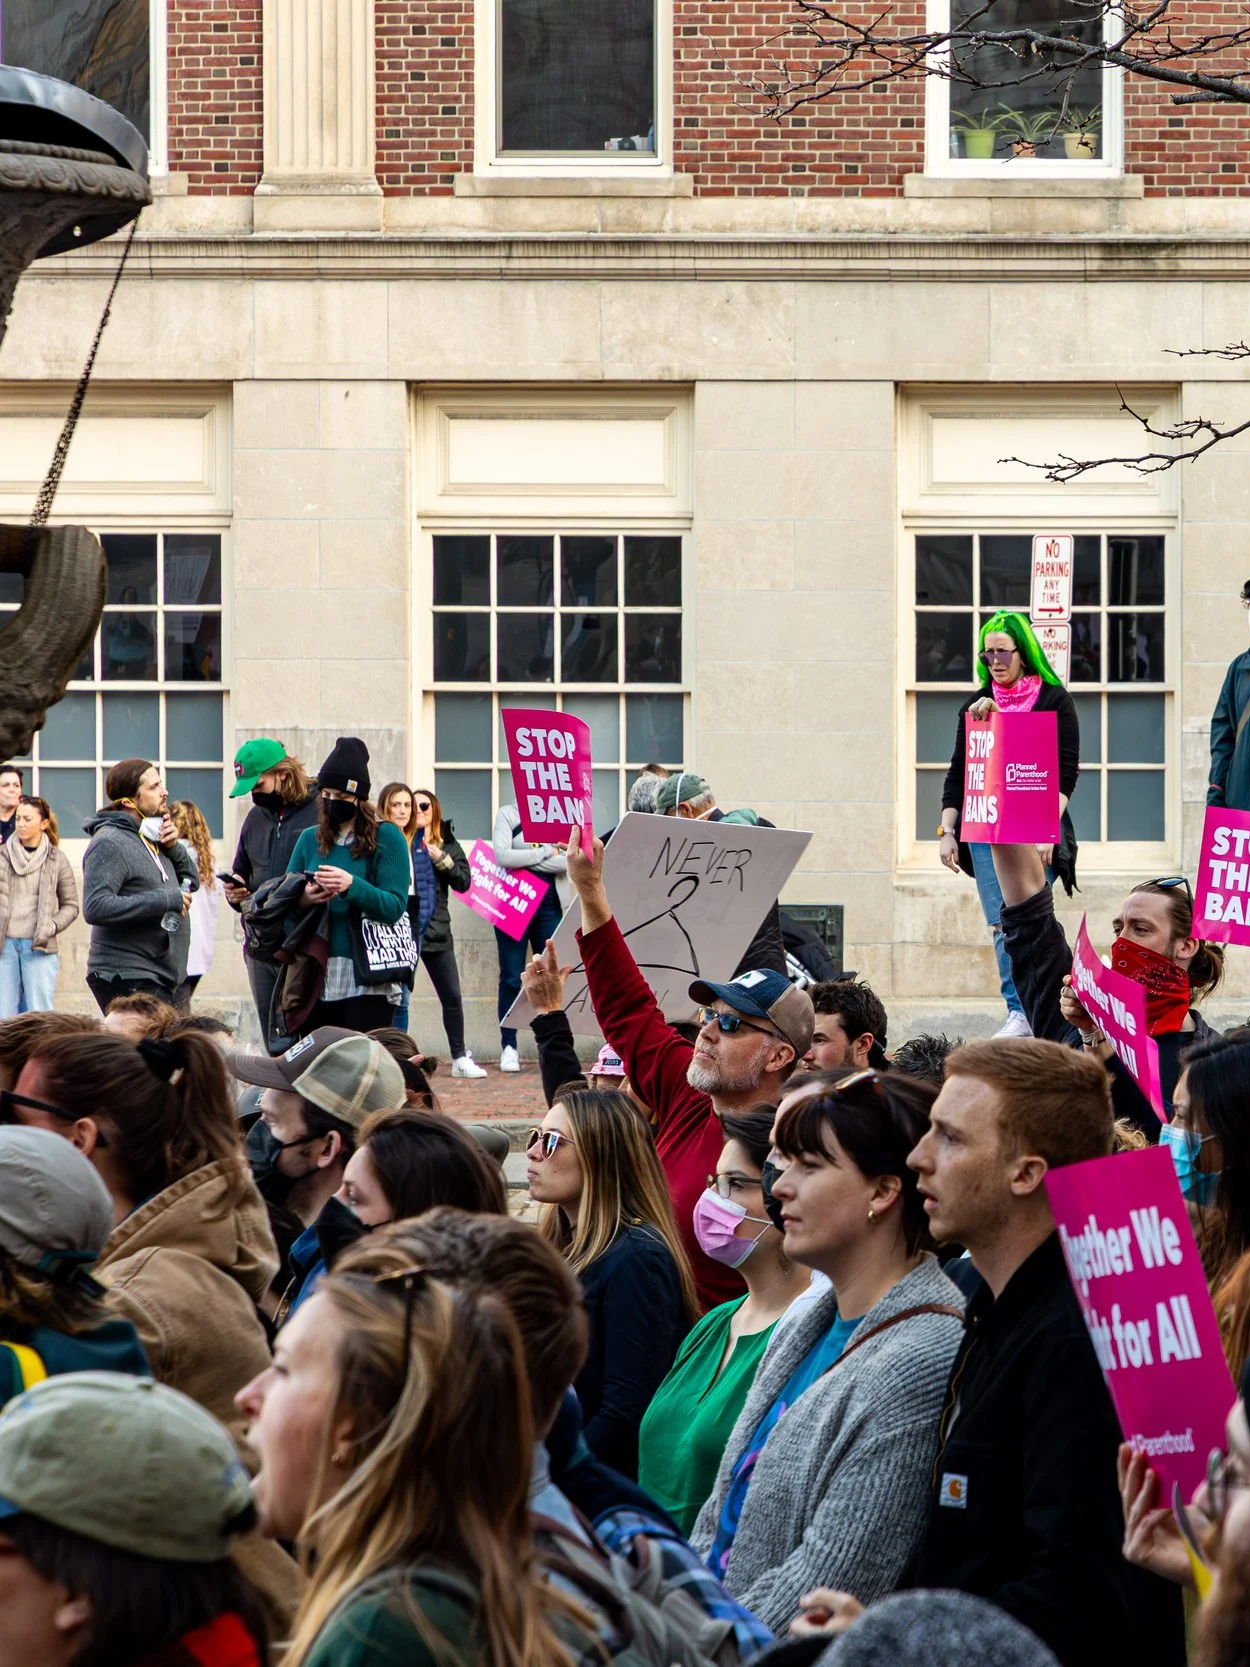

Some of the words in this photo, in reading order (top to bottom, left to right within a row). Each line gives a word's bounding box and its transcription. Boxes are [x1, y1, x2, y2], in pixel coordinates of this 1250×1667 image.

[1045, 543, 1060, 558] NO
[1035, 562, 1069, 577] PARKING
[1042, 593, 1060, 603] TIME
[1044, 580, 1059, 590] ANY
[1043, 630, 1056, 639] NO
[1043, 641, 1068, 650] RKING
[1047, 652, 1056, 660] NY
[515, 727, 576, 760] STOP
[968, 730, 995, 759] STOP
[519, 761, 573, 792] THE
[967, 763, 985, 791] THE
[964, 795, 998, 824] BANS
[474, 849, 519, 888] Together
[518, 879, 537, 900] We
[649, 836, 752, 892] NEVER
[492, 883, 511, 903] for
[508, 895, 529, 914] All
[366, 947, 398, 965] MAD
[1108, 992, 1137, 1037] We
[1129, 1204, 1184, 1270] We
[1111, 1302, 1154, 1370] for
[1155, 1293, 1203, 1364] All
